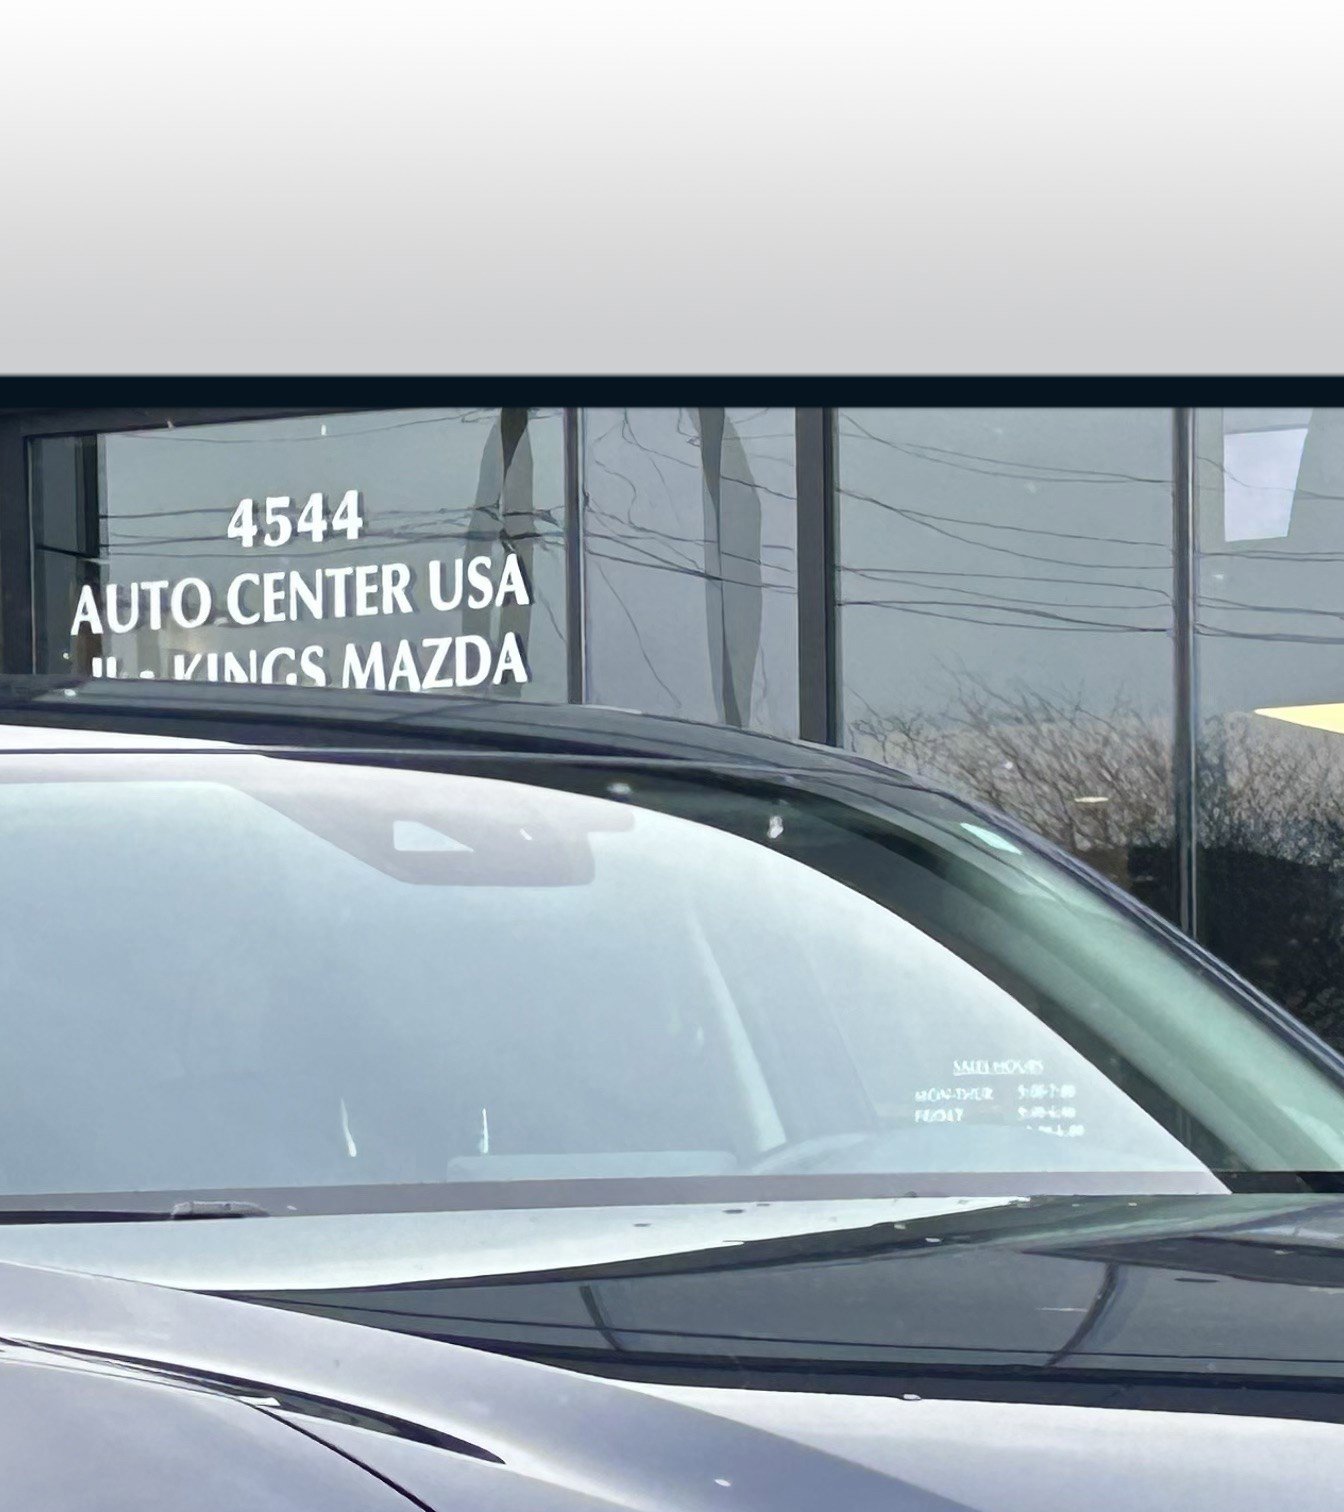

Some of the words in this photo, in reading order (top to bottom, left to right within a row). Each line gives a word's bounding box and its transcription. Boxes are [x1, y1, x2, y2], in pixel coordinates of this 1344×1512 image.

[227, 489, 363, 548] 4544
[70, 577, 212, 636] AUTO
[226, 562, 413, 625] CENTER
[428, 553, 530, 611] USA
[342, 631, 528, 693] MAZDA
